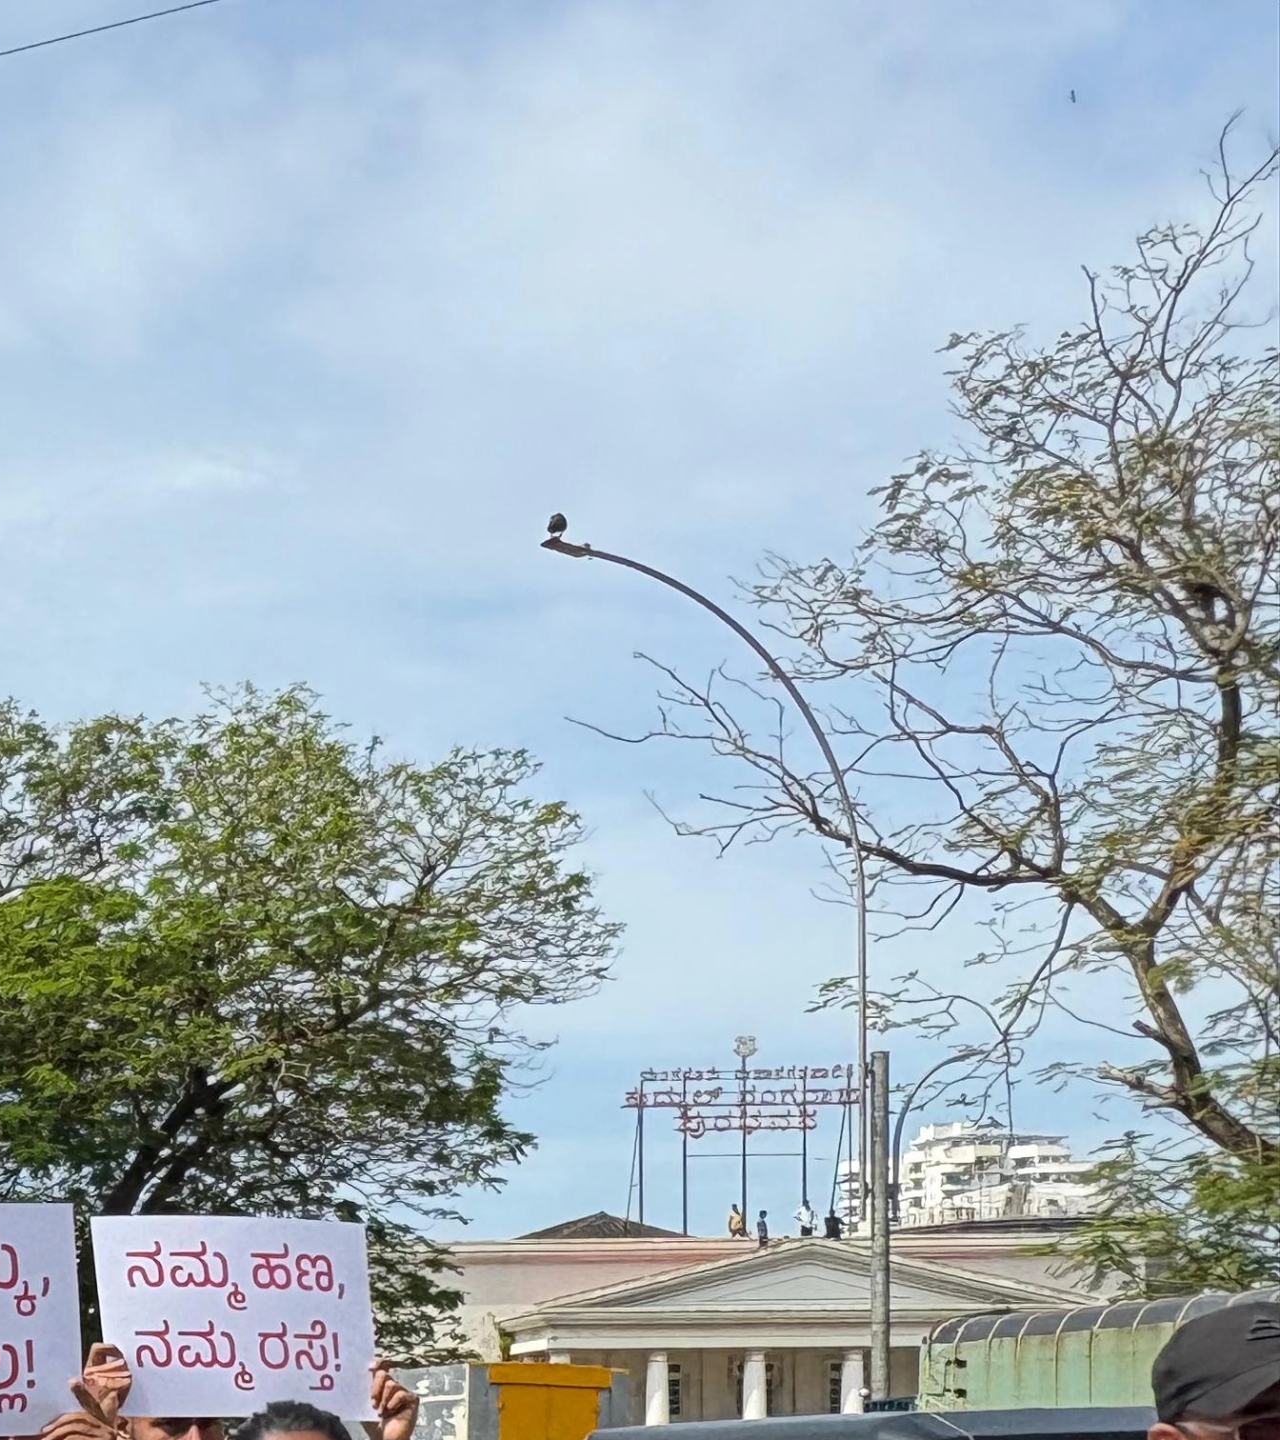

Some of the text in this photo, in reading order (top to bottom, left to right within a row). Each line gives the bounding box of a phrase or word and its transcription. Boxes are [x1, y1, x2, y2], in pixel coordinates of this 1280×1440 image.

[126, 1241, 344, 1311] ನಮ್ಮ ಹಣ,
[135, 1320, 341, 1391] ನಮ್ಮ ರಸ್ತೆ!
